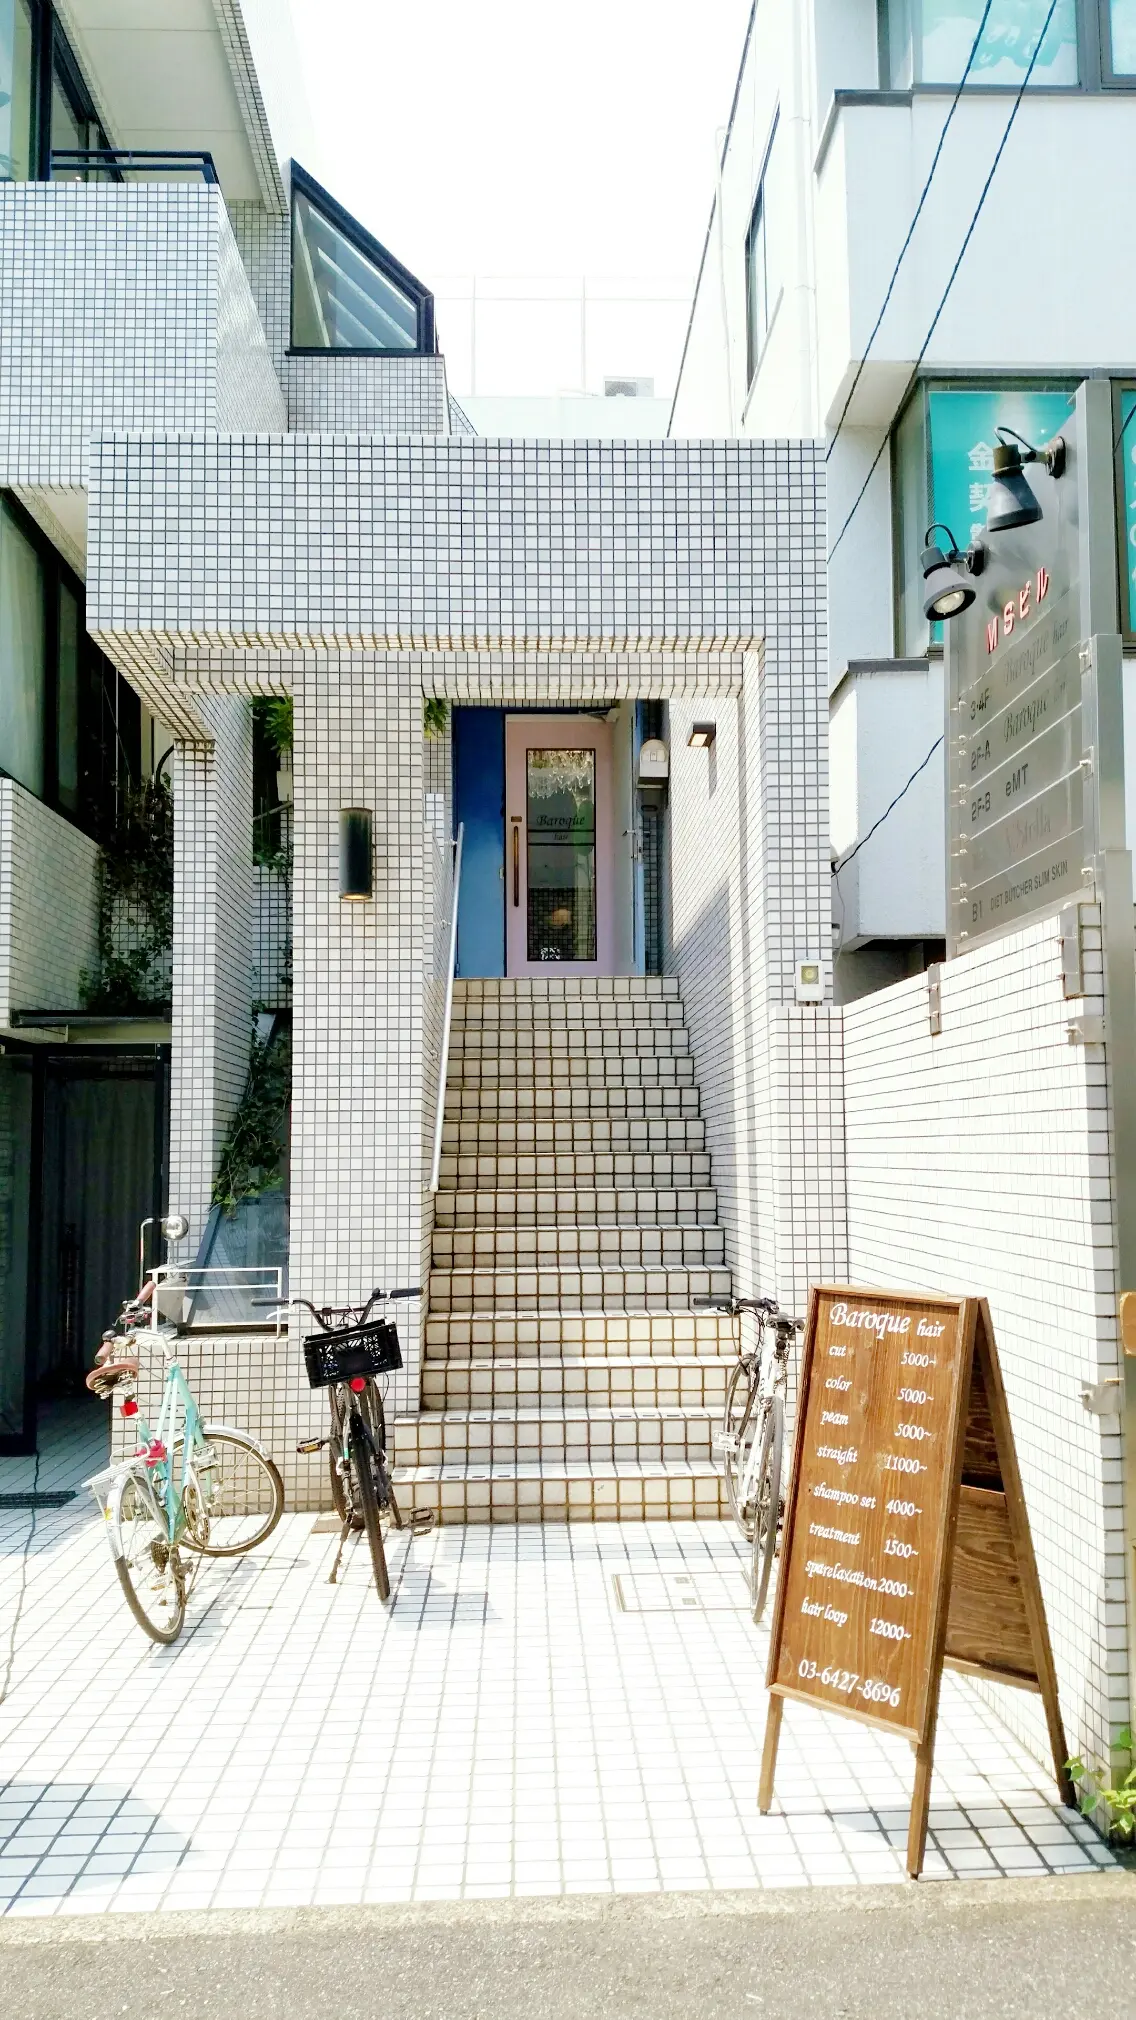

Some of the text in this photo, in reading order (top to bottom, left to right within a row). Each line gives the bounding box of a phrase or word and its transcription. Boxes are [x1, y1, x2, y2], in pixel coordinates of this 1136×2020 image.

[1006, 763, 1029, 797] eMT
[536, 813, 586, 829] Baroque
[973, 860, 1068, 922] B1 DIET BUTCHER SLIM SKIN
[830, 1302, 946, 1340] Baroque hair
[829, 1344, 847, 1357] cut
[825, 1375, 853, 1392] color
[816, 1445, 858, 1466] straight
[813, 1481, 859, 1506] shampoo
[860, 1496, 877, 1509] set
[809, 1522, 861, 1545] treatment
[801, 1596, 825, 1617] hair
[823, 1604, 849, 1628] loop
[798, 1659, 902, 1708] 03-6427-8696
